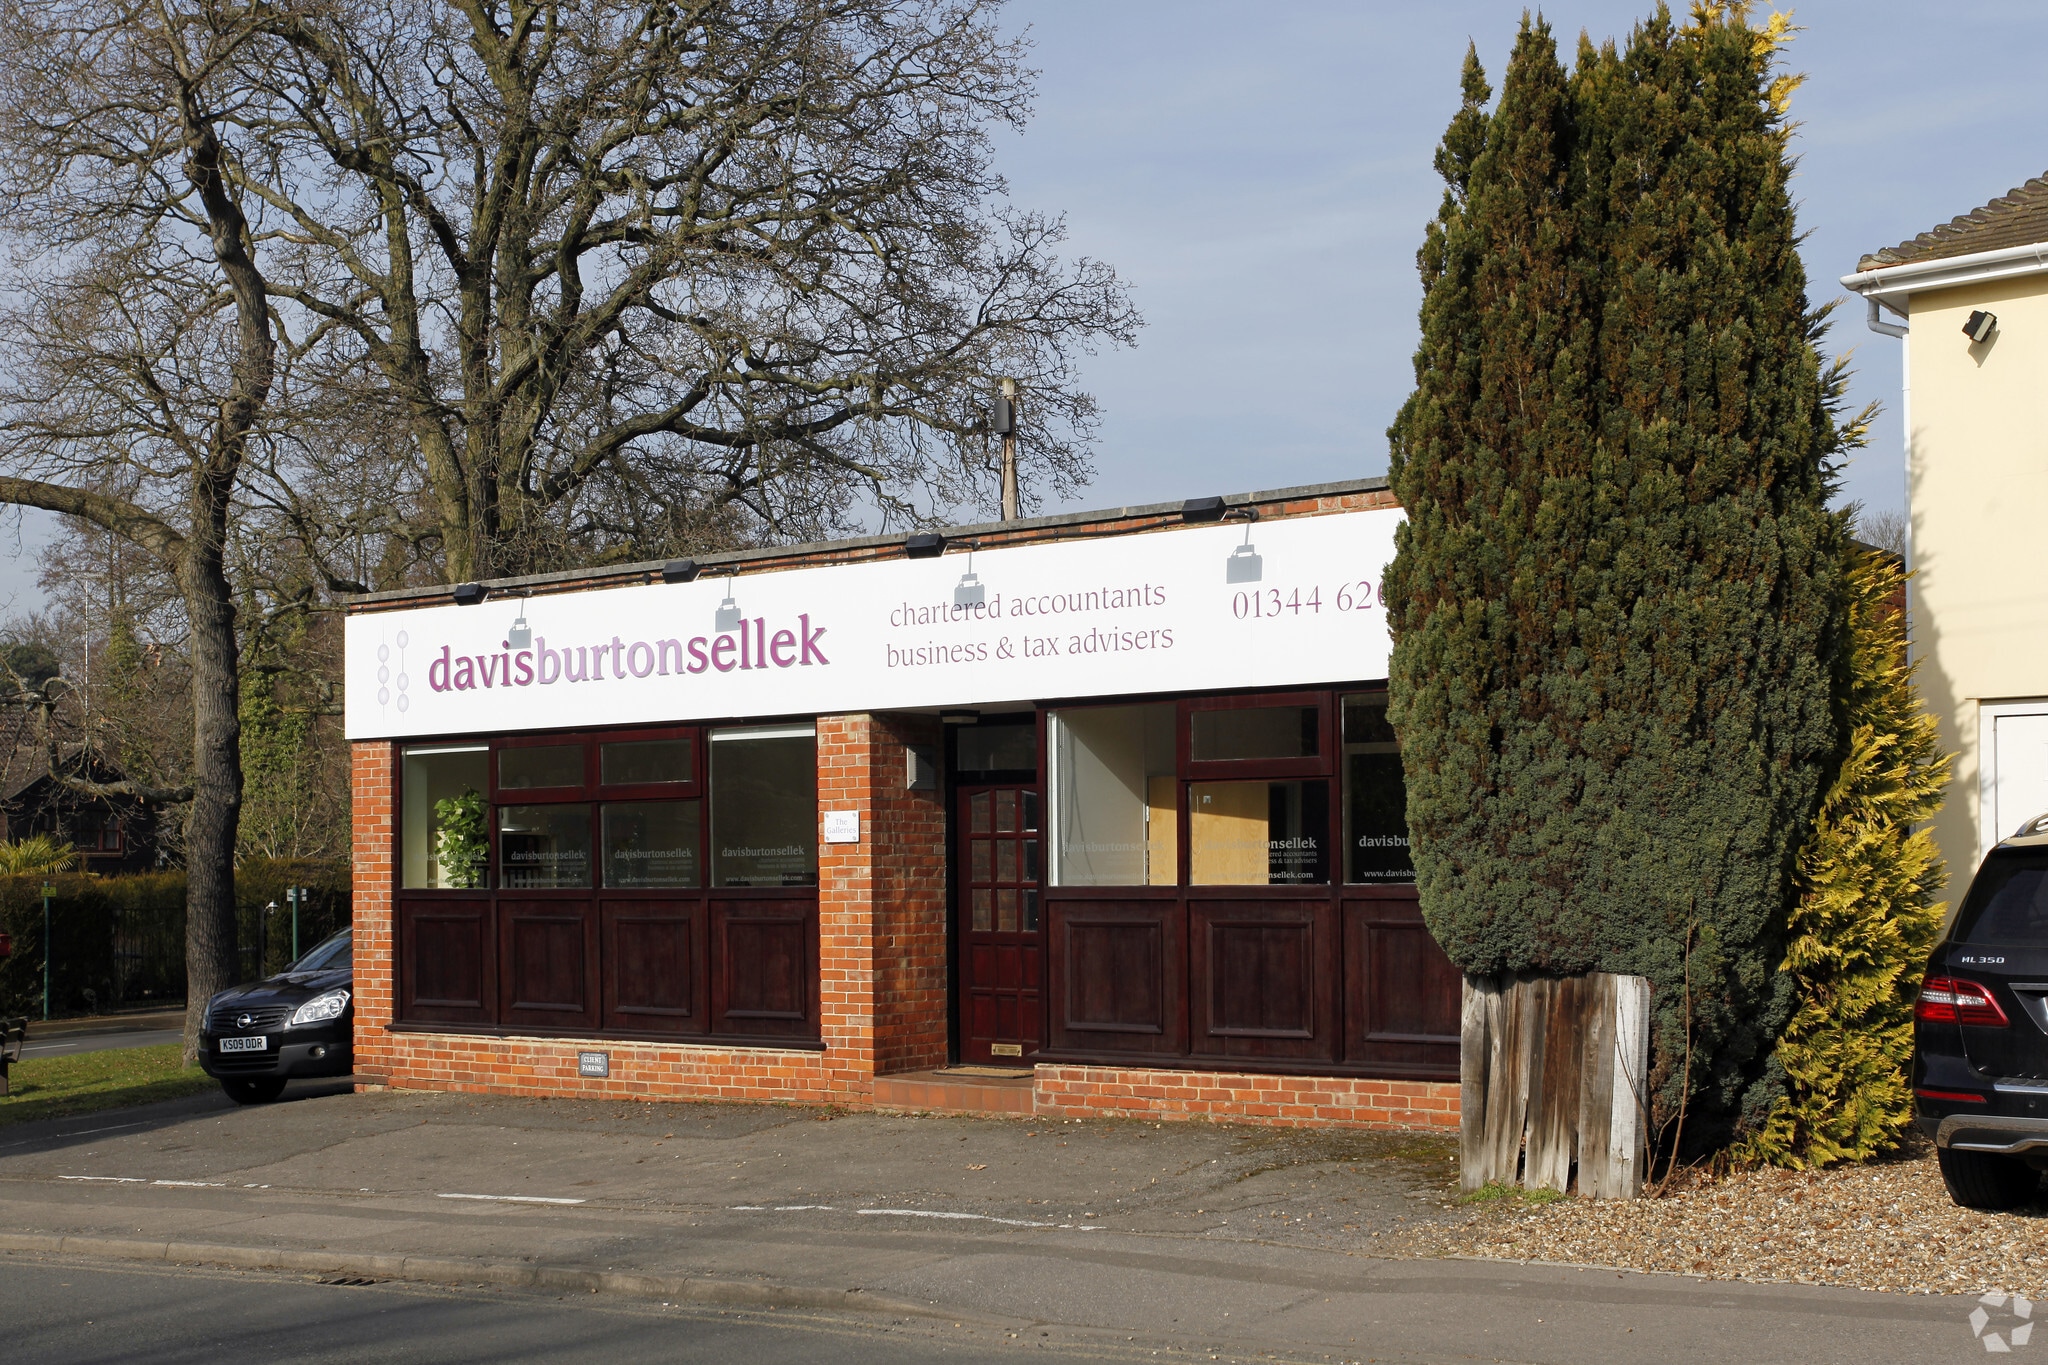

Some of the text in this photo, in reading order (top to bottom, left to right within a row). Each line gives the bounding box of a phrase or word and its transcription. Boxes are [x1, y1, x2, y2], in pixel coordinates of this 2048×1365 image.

[890, 583, 1166, 628] chartered accountants
[1233, 587, 1322, 620] 01344
[887, 625, 1174, 668] business & tax advisers
[428, 613, 829, 692] davisburtonsellek
[835, 818, 848, 826] The
[826, 826, 857, 834] Galleries
[511, 849, 585, 860] davisburtonsellek
[614, 847, 693, 859] davisburtonsellek
[721, 845, 805, 857] davisburtonsellek
[1978, 956, 2005, 964] 350
[223, 1039, 244, 1050] KS09
[583, 1056, 602, 1064] CLIENT
[582, 1064, 604, 1073] PARKING
